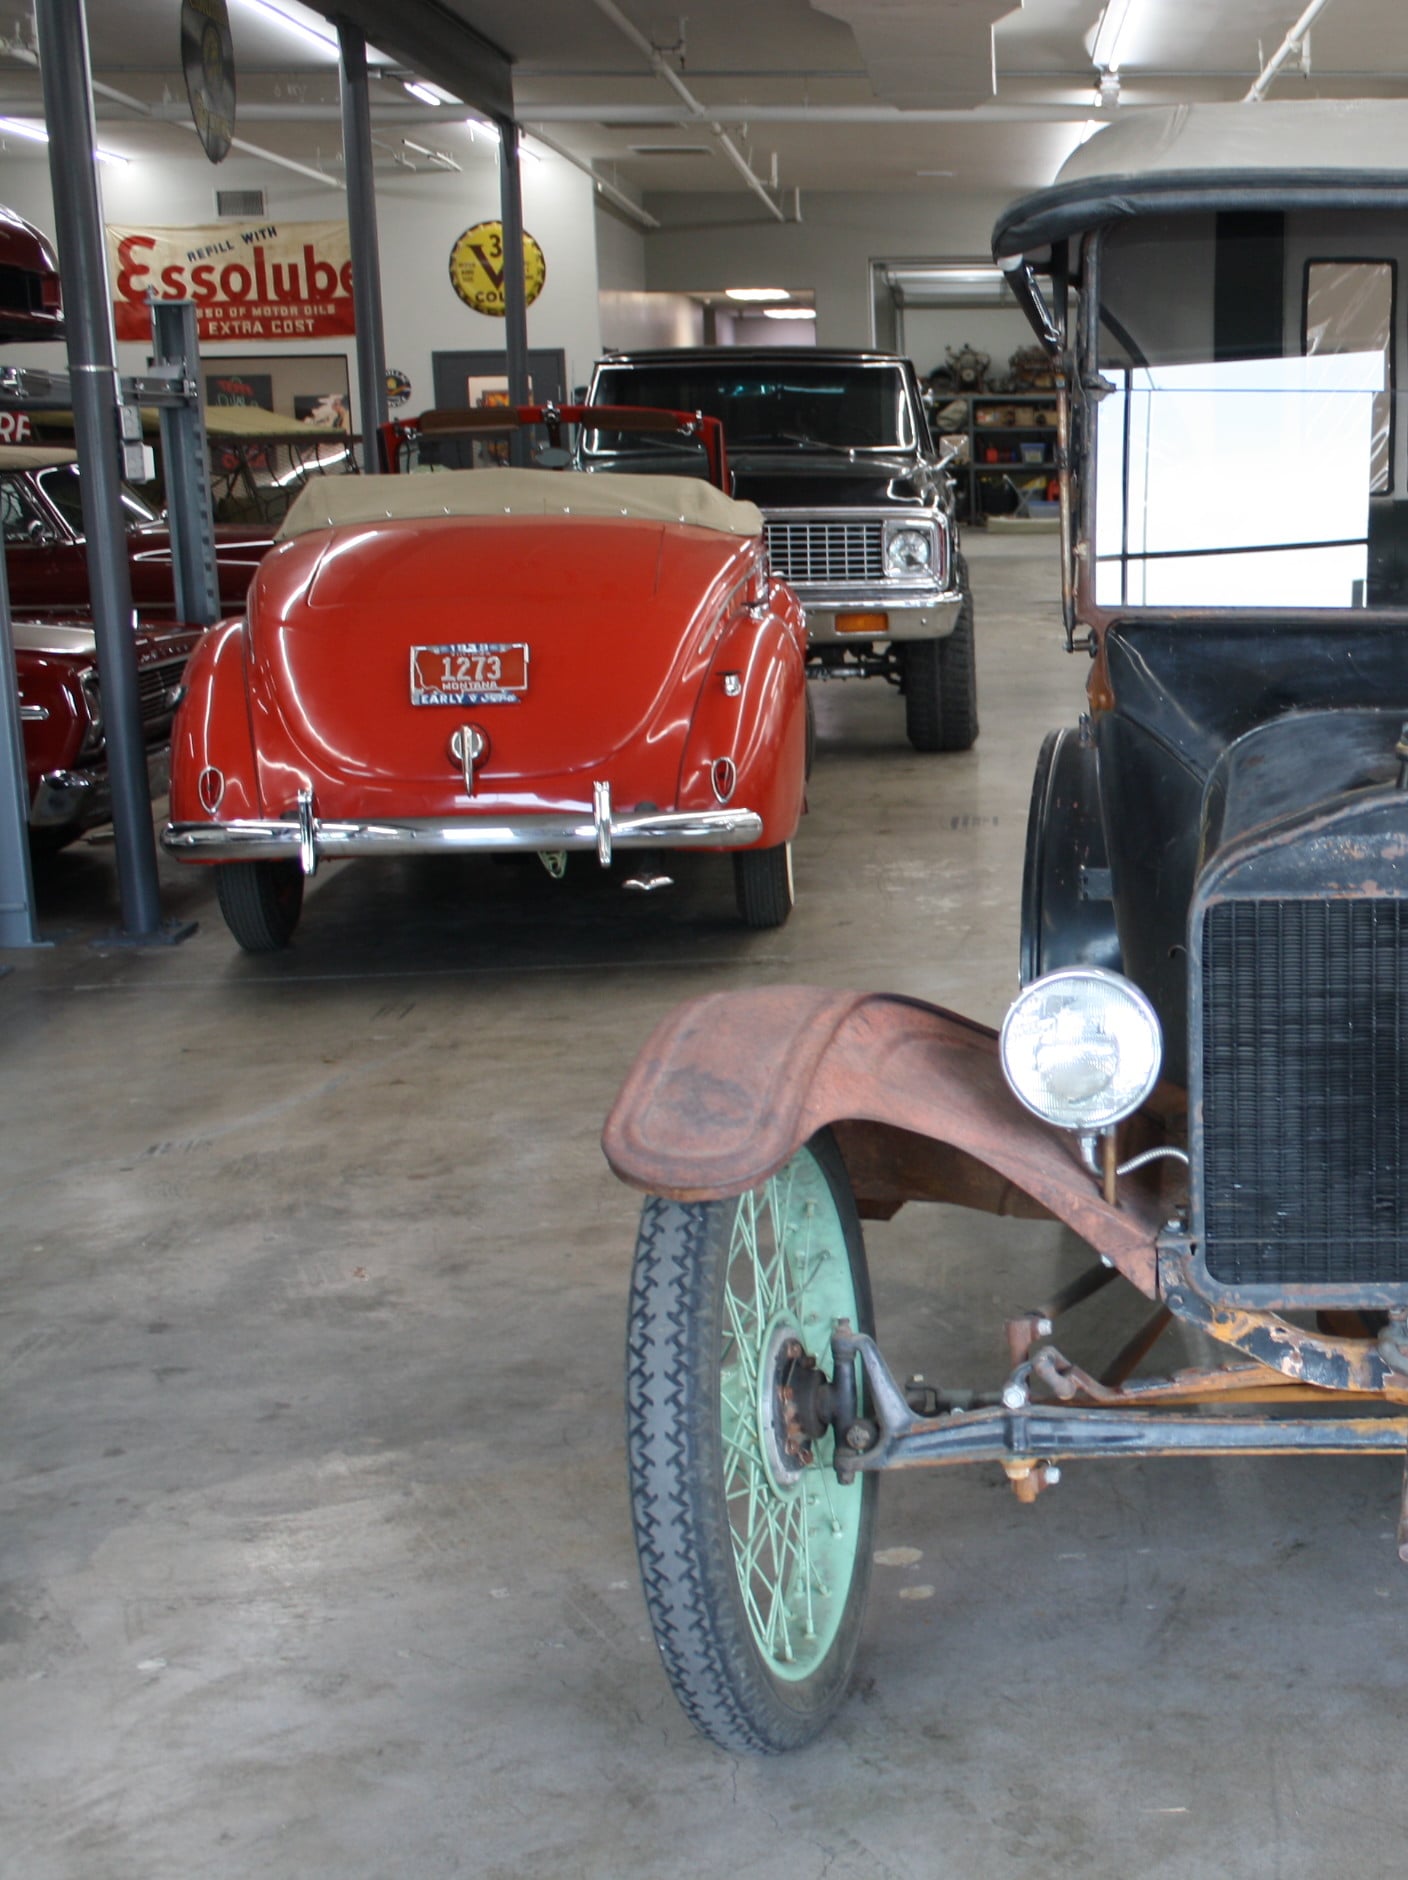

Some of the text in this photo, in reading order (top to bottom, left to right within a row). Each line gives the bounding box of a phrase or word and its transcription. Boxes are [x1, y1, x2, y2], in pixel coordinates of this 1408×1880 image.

[187, 226, 278, 262] REFILL WITH
[229, 306, 246, 318] OF
[251, 305, 299, 317] MOTOR
[303, 304, 336, 315] OILS
[208, 320, 264, 335] EXTRA
[271, 319, 315, 334] COST
[441, 656, 502, 681] 1273
[442, 681, 498, 691] MONTANA
[421, 693, 464, 704] EARLY
